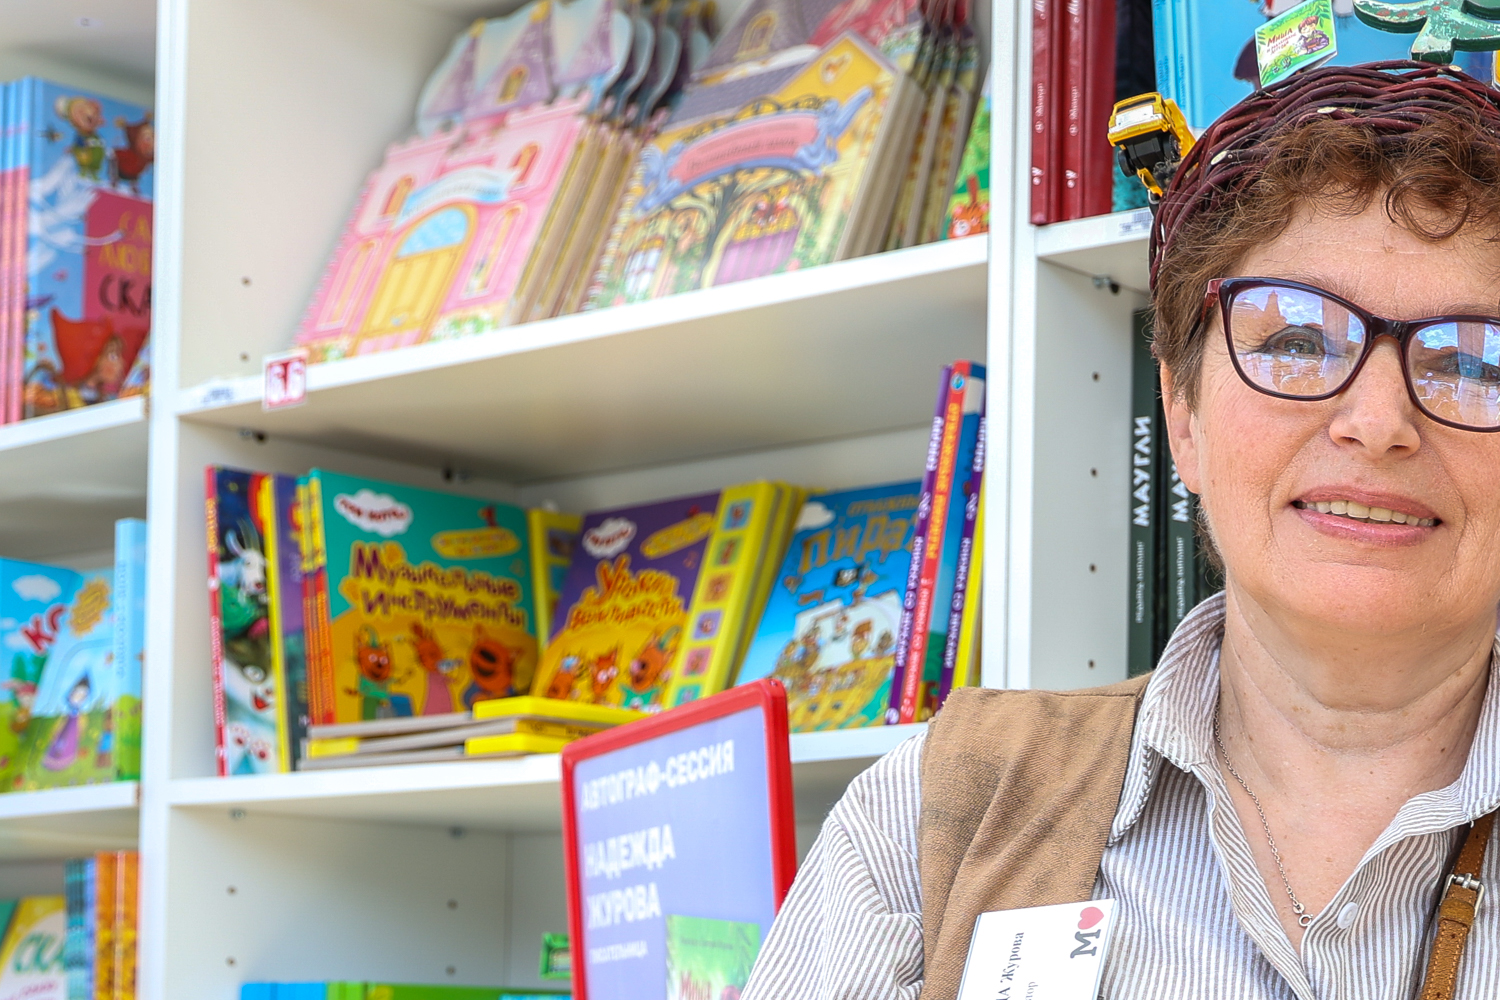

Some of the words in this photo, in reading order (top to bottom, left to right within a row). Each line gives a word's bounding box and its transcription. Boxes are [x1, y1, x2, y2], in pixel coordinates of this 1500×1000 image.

[1133, 415, 1151, 527] МАУГЛИ
[579, 739, 735, 812] АВТОГРАФ-СЕССИЯ
[584, 823, 676, 880] НАДЕЖДА
[587, 882, 662, 929] ЖУРОВА
[1000, 932, 1025, 983] Журова
